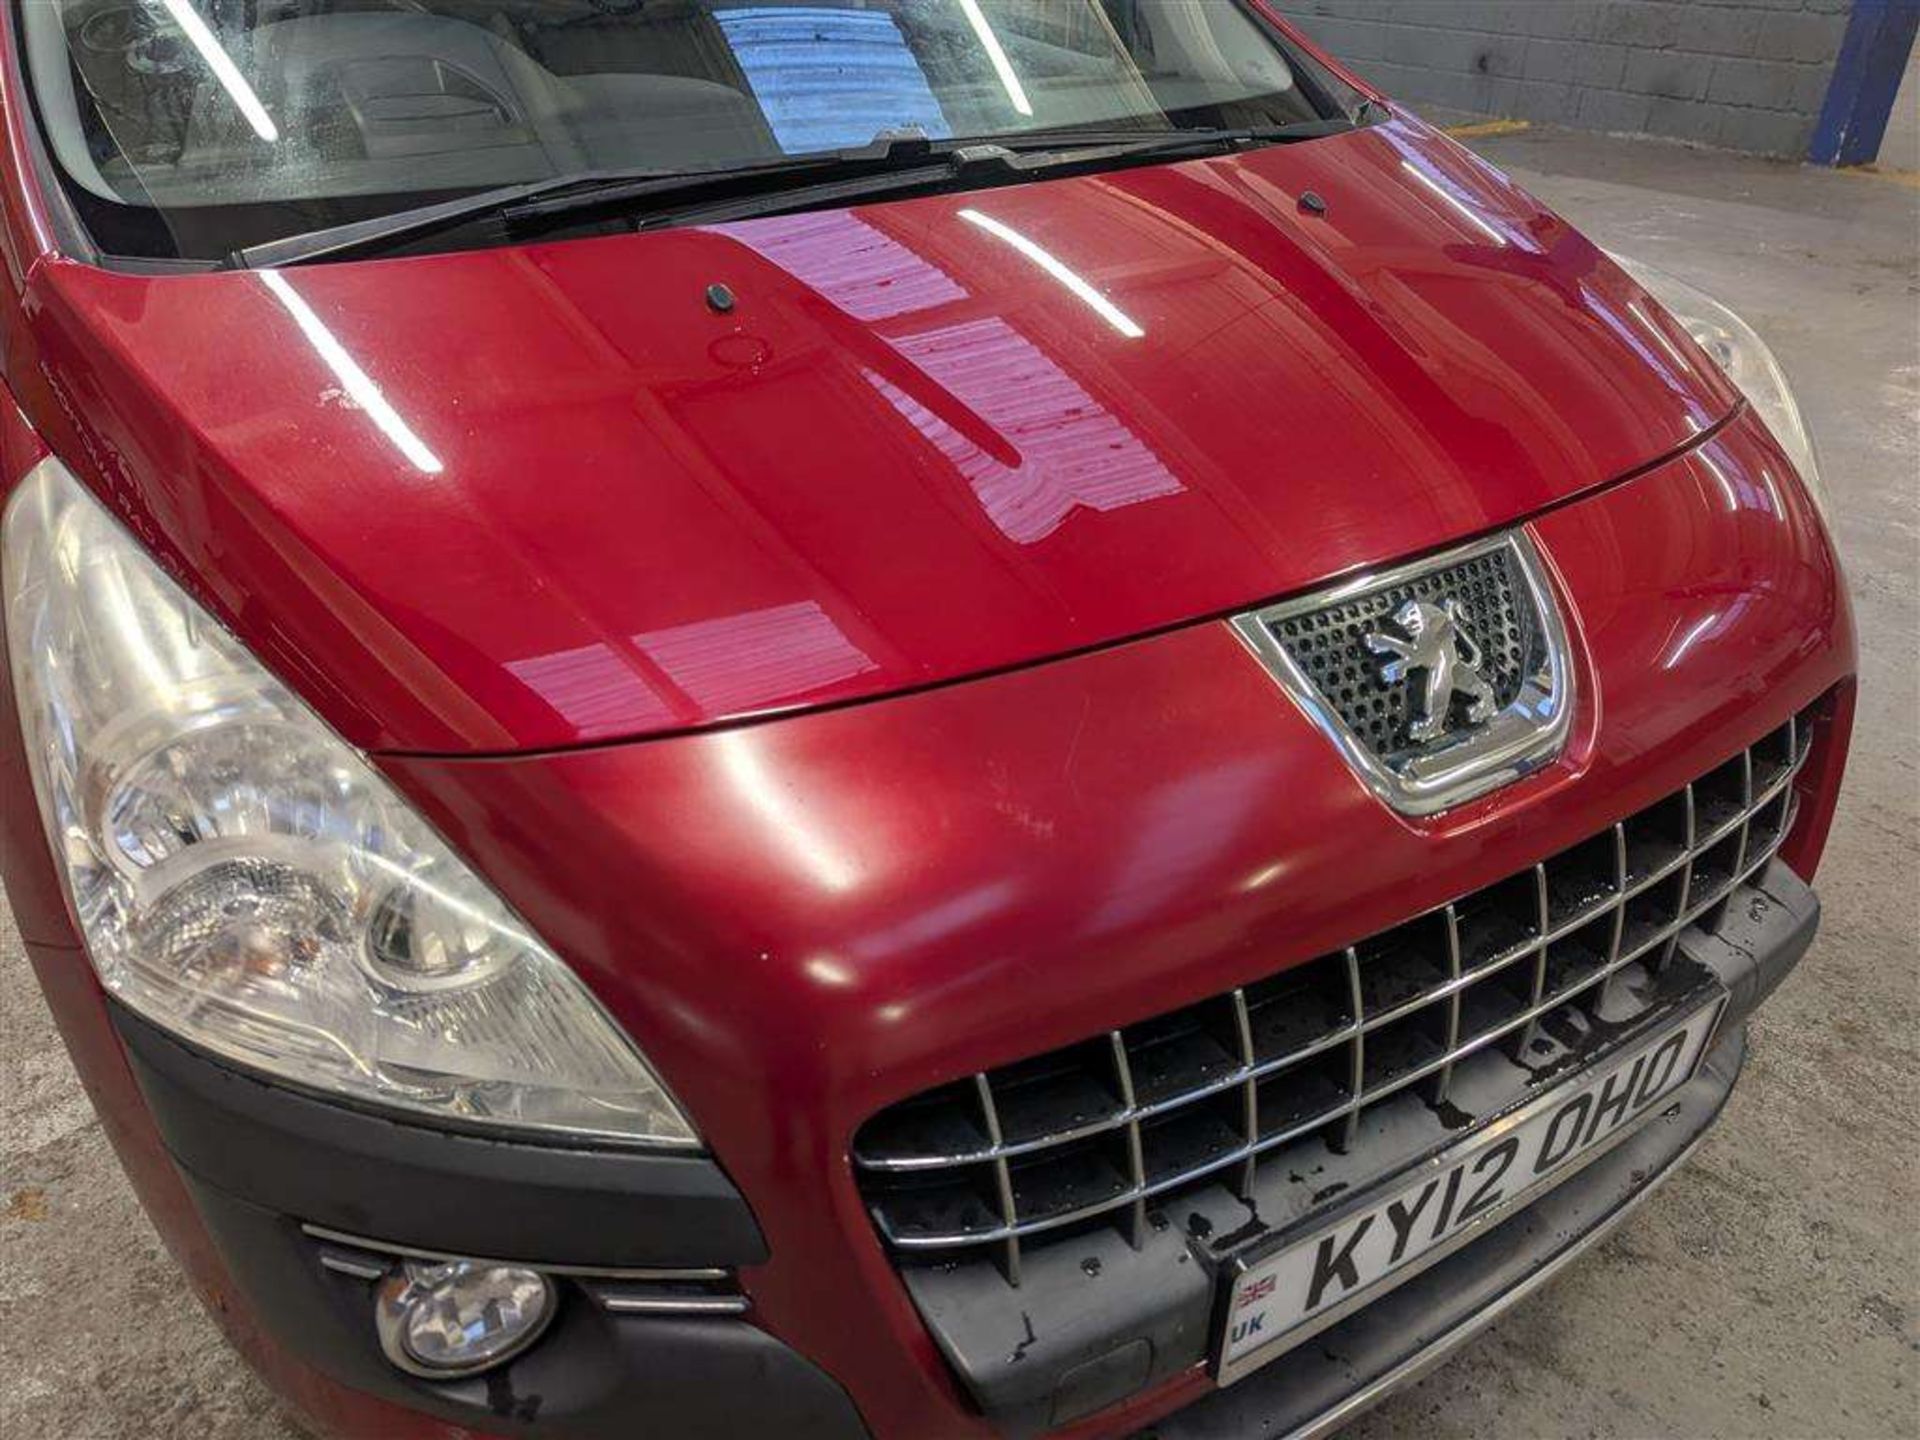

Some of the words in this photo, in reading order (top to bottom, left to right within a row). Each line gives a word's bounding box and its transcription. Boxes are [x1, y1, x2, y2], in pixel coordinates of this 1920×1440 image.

[1304, 1136, 1519, 1312] KY12
[1533, 1029, 1688, 1174] OHO
[1231, 1312, 1265, 1343] UK
